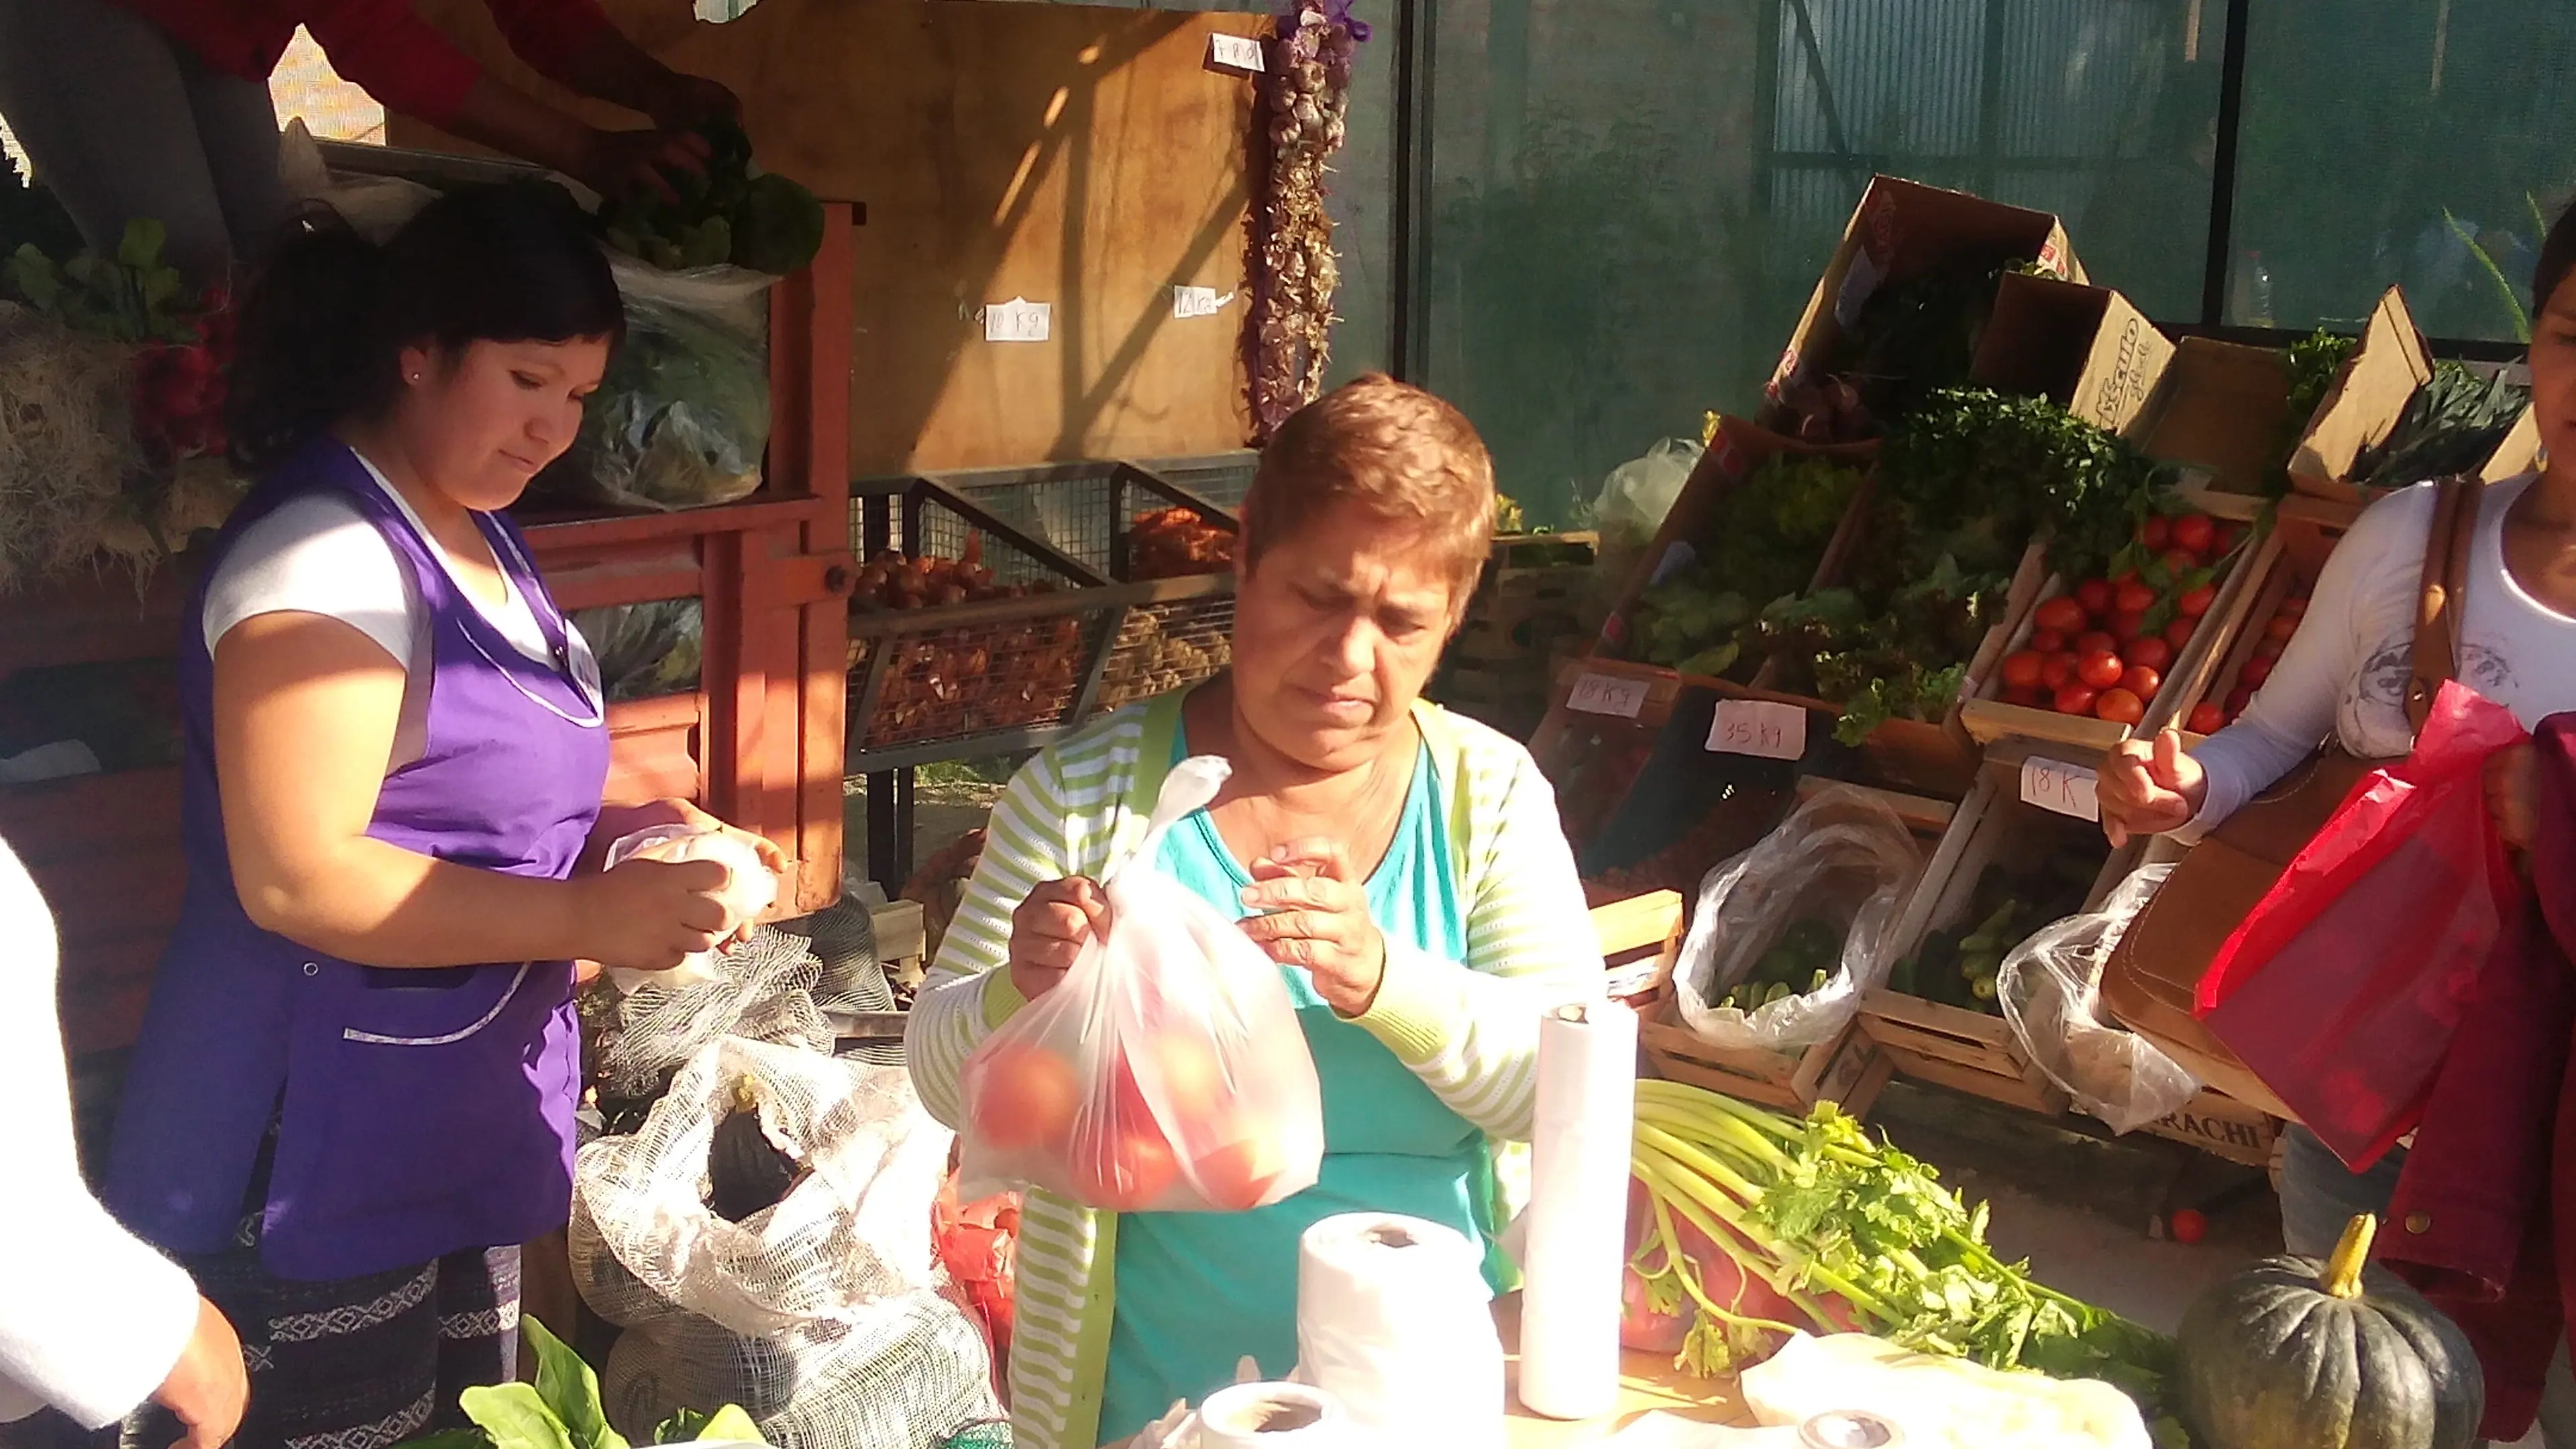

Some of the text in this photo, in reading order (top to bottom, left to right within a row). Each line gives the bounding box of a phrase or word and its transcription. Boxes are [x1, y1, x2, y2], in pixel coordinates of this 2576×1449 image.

[1727, 721, 1752, 744] 35
[2032, 766, 2051, 796] 18
[2151, 1110, 2262, 1150] RACHI
